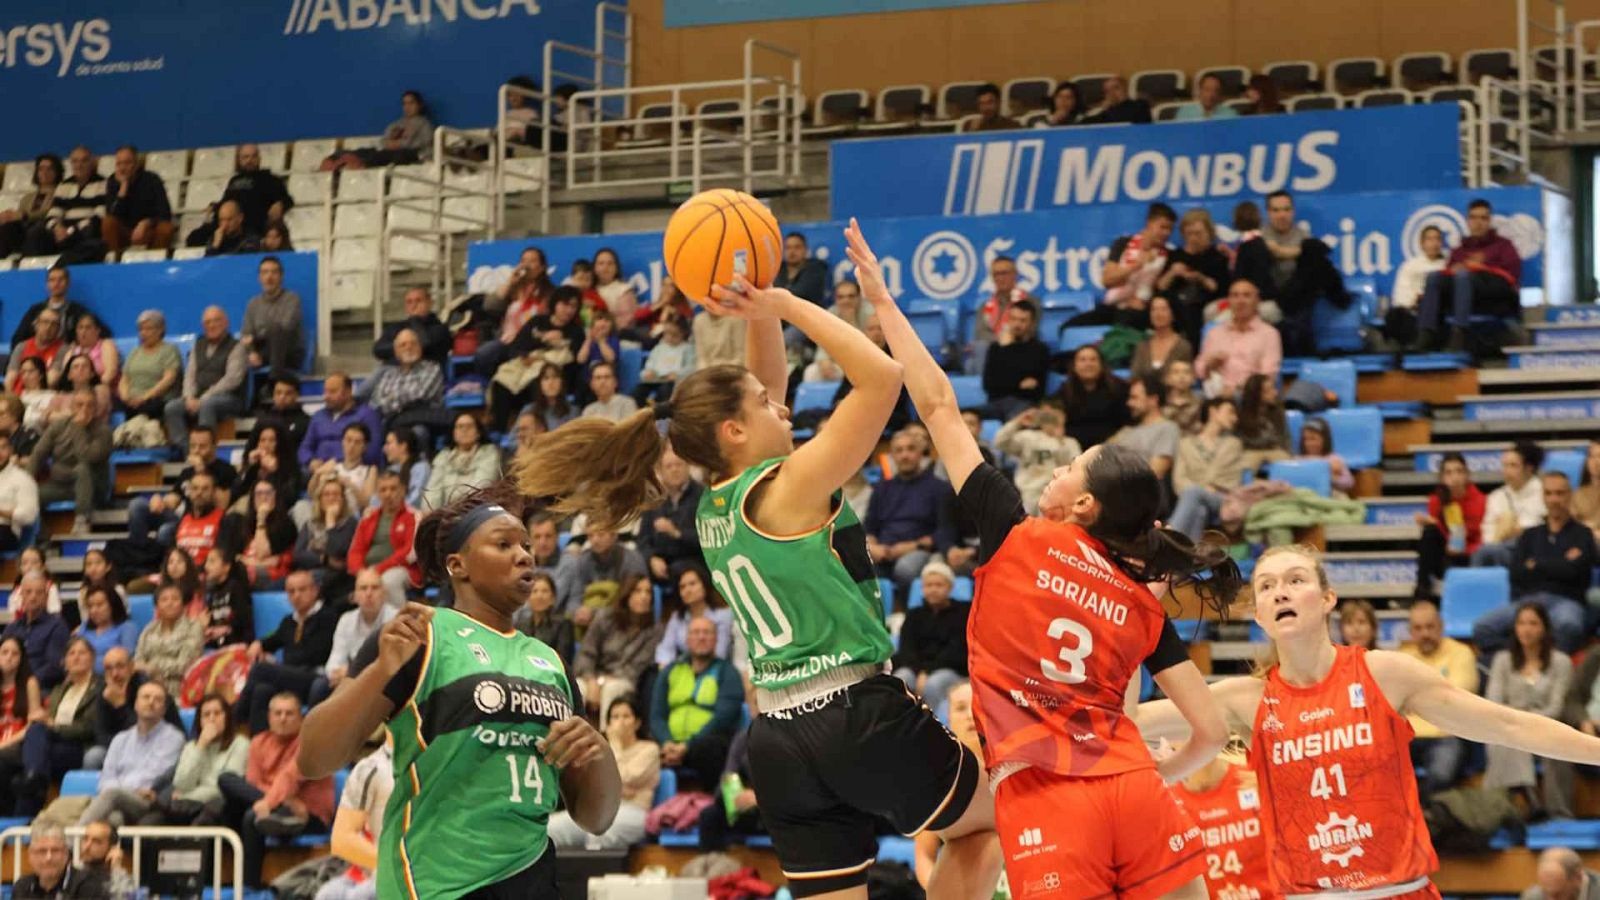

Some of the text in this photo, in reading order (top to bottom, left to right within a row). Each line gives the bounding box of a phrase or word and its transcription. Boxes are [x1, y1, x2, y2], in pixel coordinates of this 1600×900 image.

[0, 18, 111, 78] rsys
[1036, 568, 1128, 626] SORIANO
[1039, 617, 1094, 684] 3
[511, 690, 574, 721] PROBITA
[1272, 722, 1373, 766] ENSINO
[505, 754, 544, 805] 14
[1310, 763, 1348, 801] 41
[1200, 818, 1260, 849] SINO
[1206, 849, 1244, 880] 24
